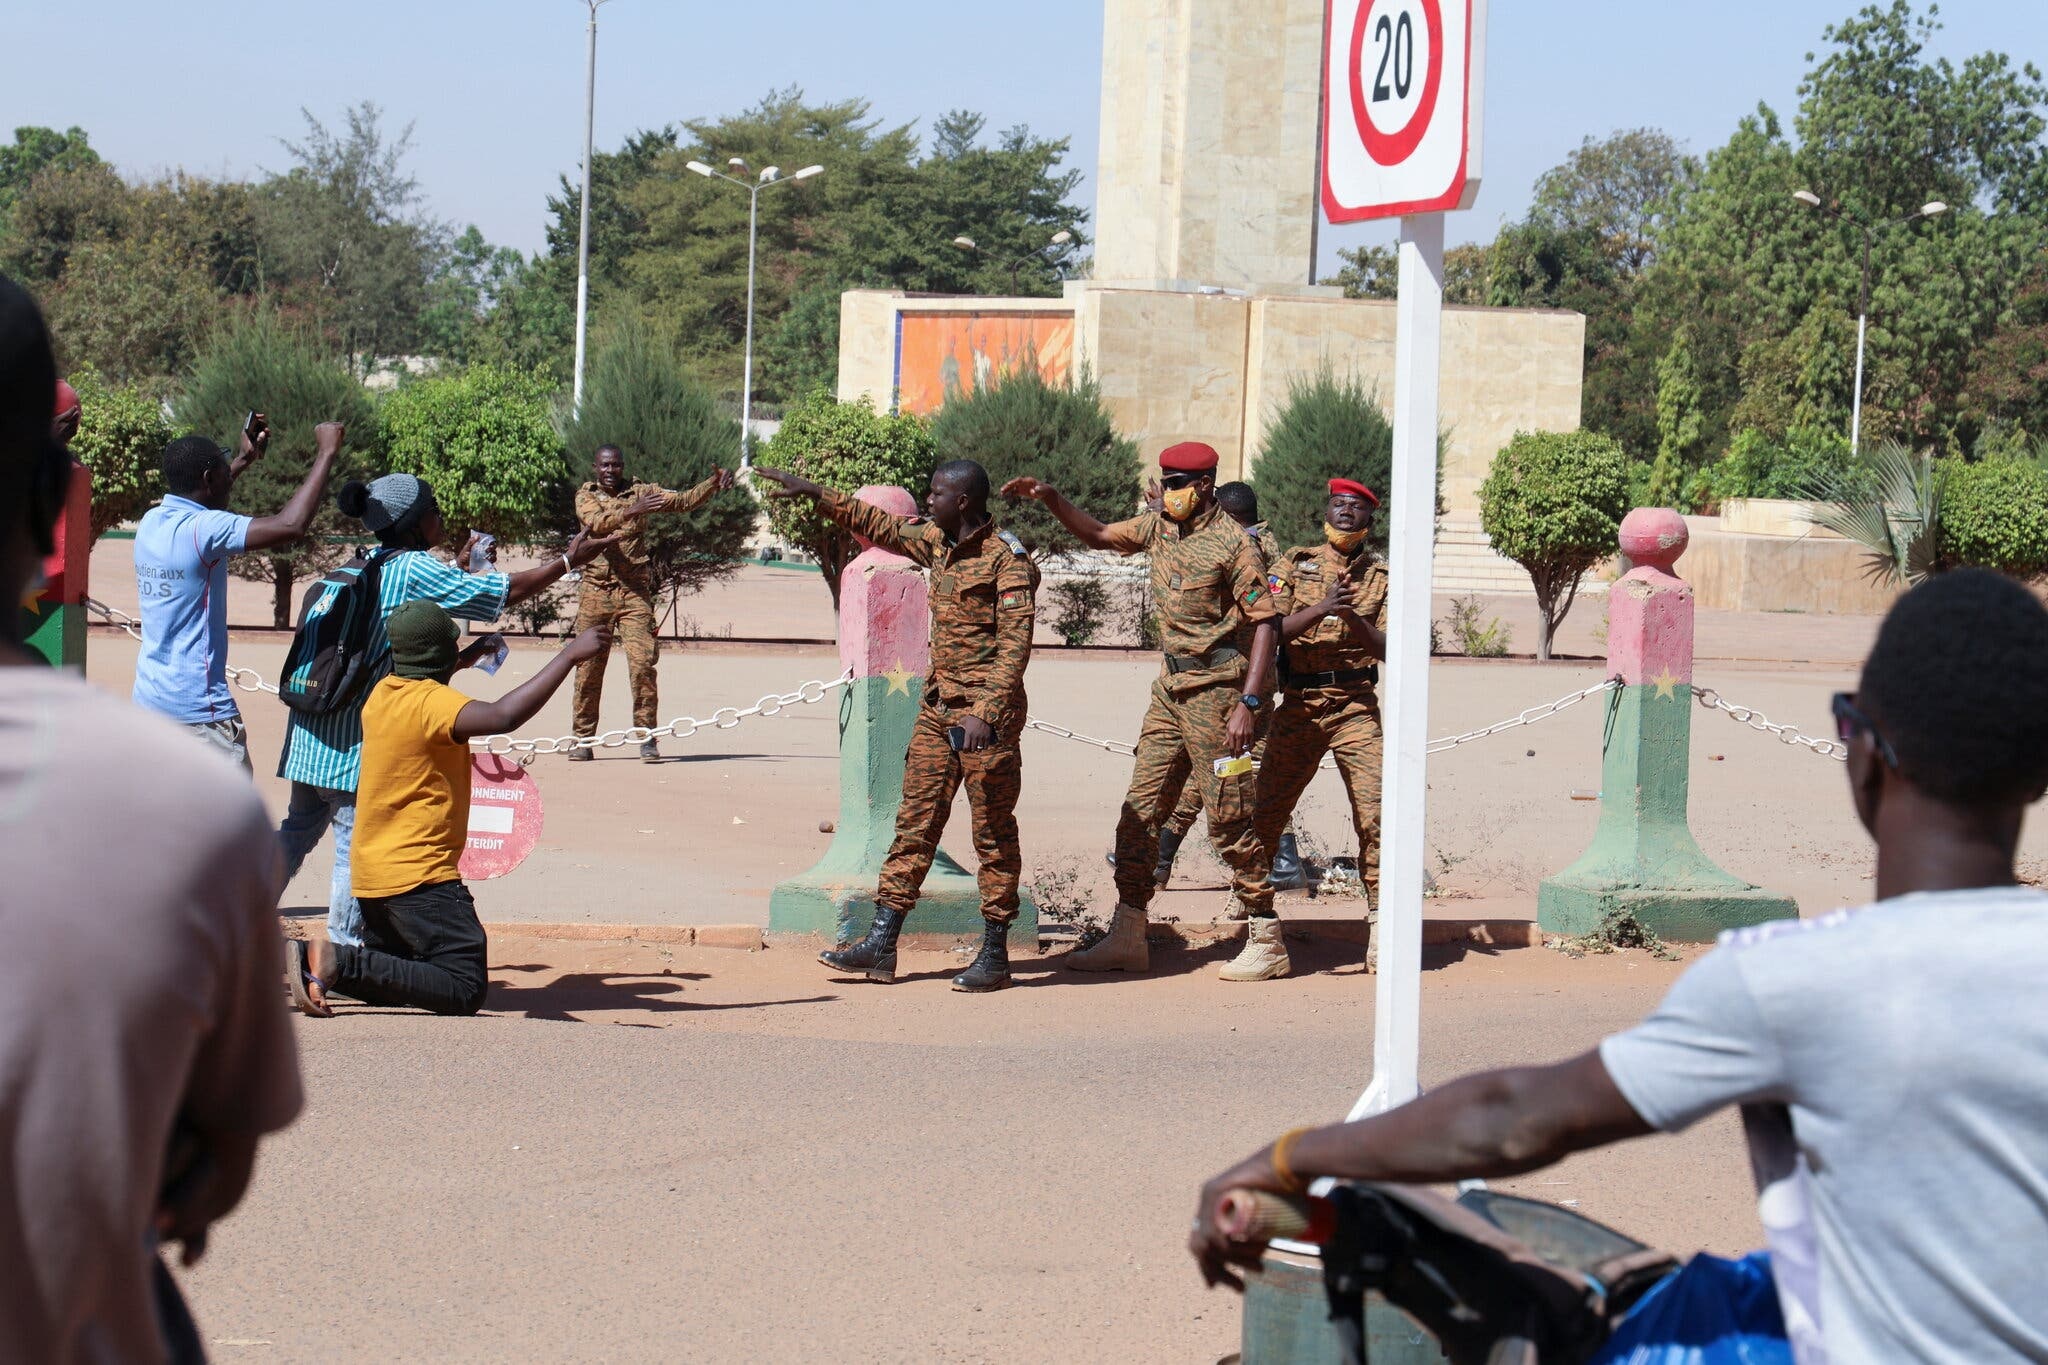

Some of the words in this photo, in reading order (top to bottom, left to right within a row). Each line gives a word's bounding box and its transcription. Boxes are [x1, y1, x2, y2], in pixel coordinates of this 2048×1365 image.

[1372, 10, 1413, 103] 20
[160, 569, 185, 580] aux
[138, 579, 172, 598] .D.S
